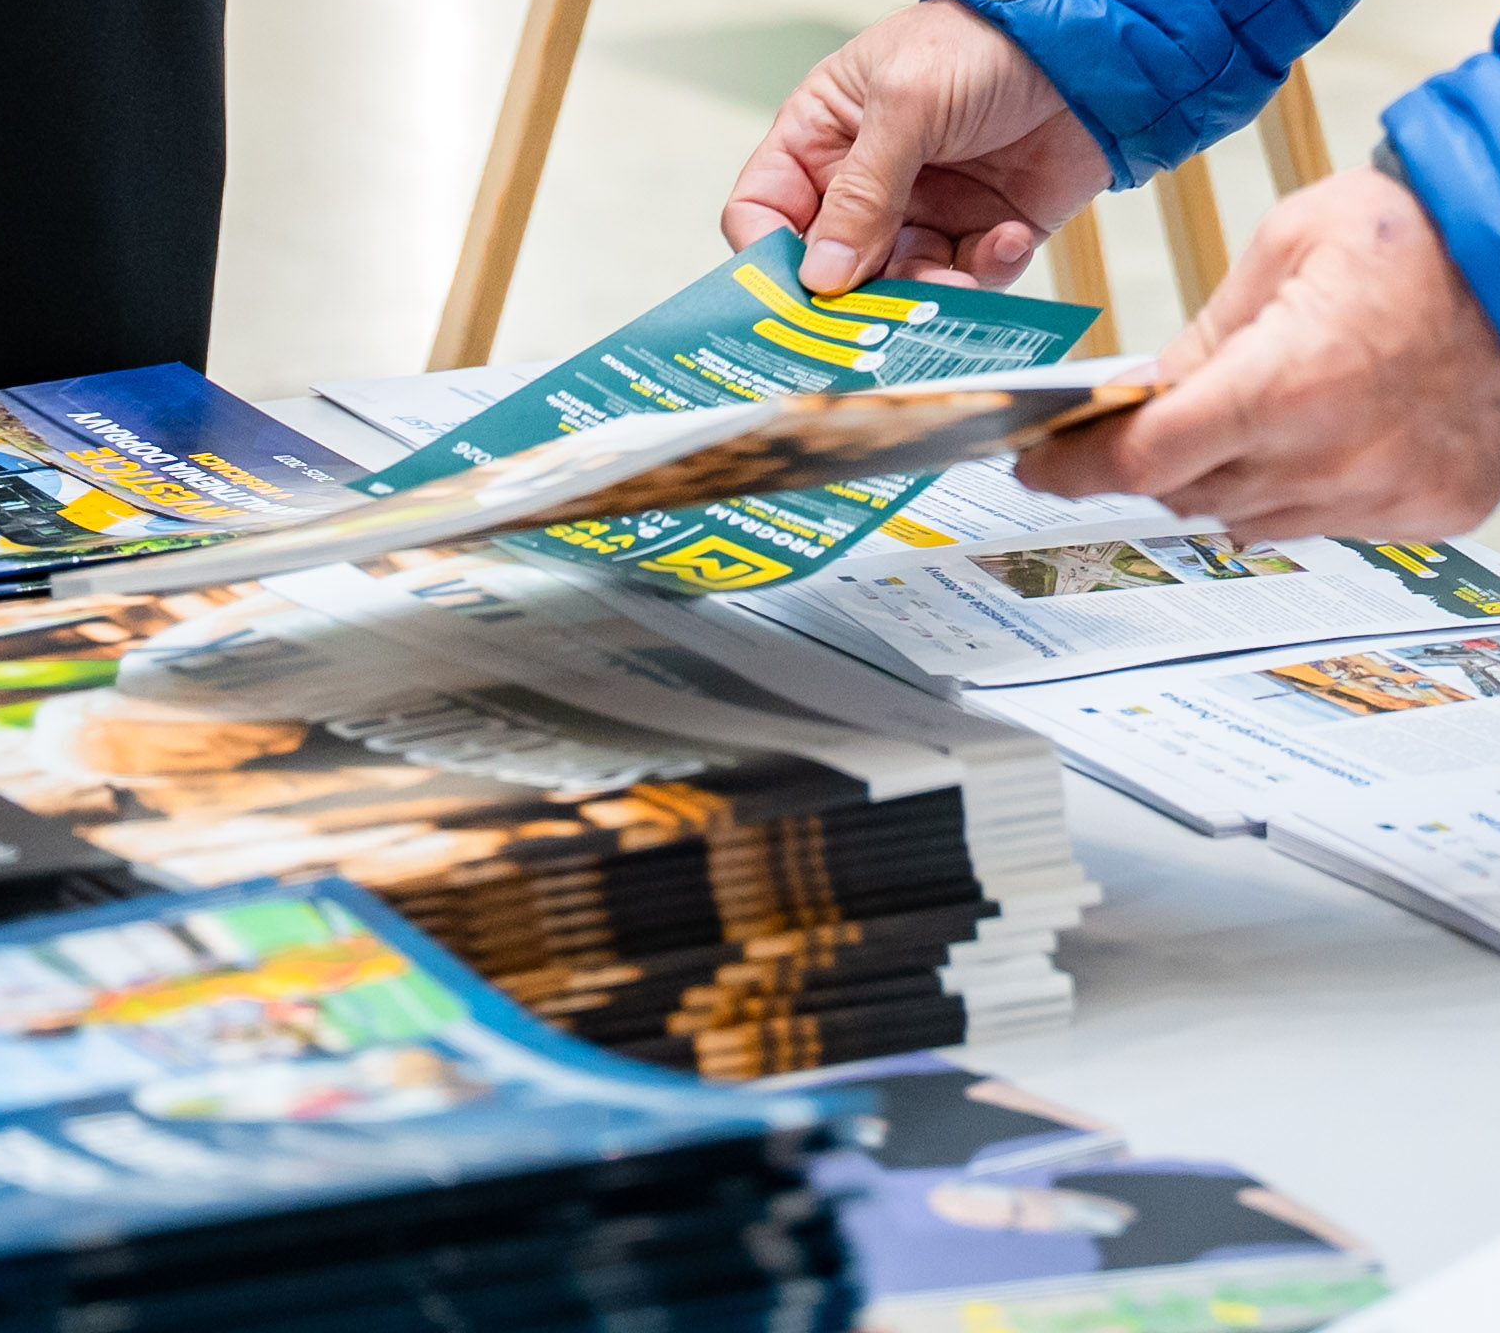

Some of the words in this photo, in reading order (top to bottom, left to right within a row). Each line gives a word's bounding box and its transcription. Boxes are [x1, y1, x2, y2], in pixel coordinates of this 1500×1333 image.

[66, 411, 177, 463] DOPRAVY
[65, 446, 248, 519] INVESTÍCIE
[705, 503, 824, 558] PROGRAM
